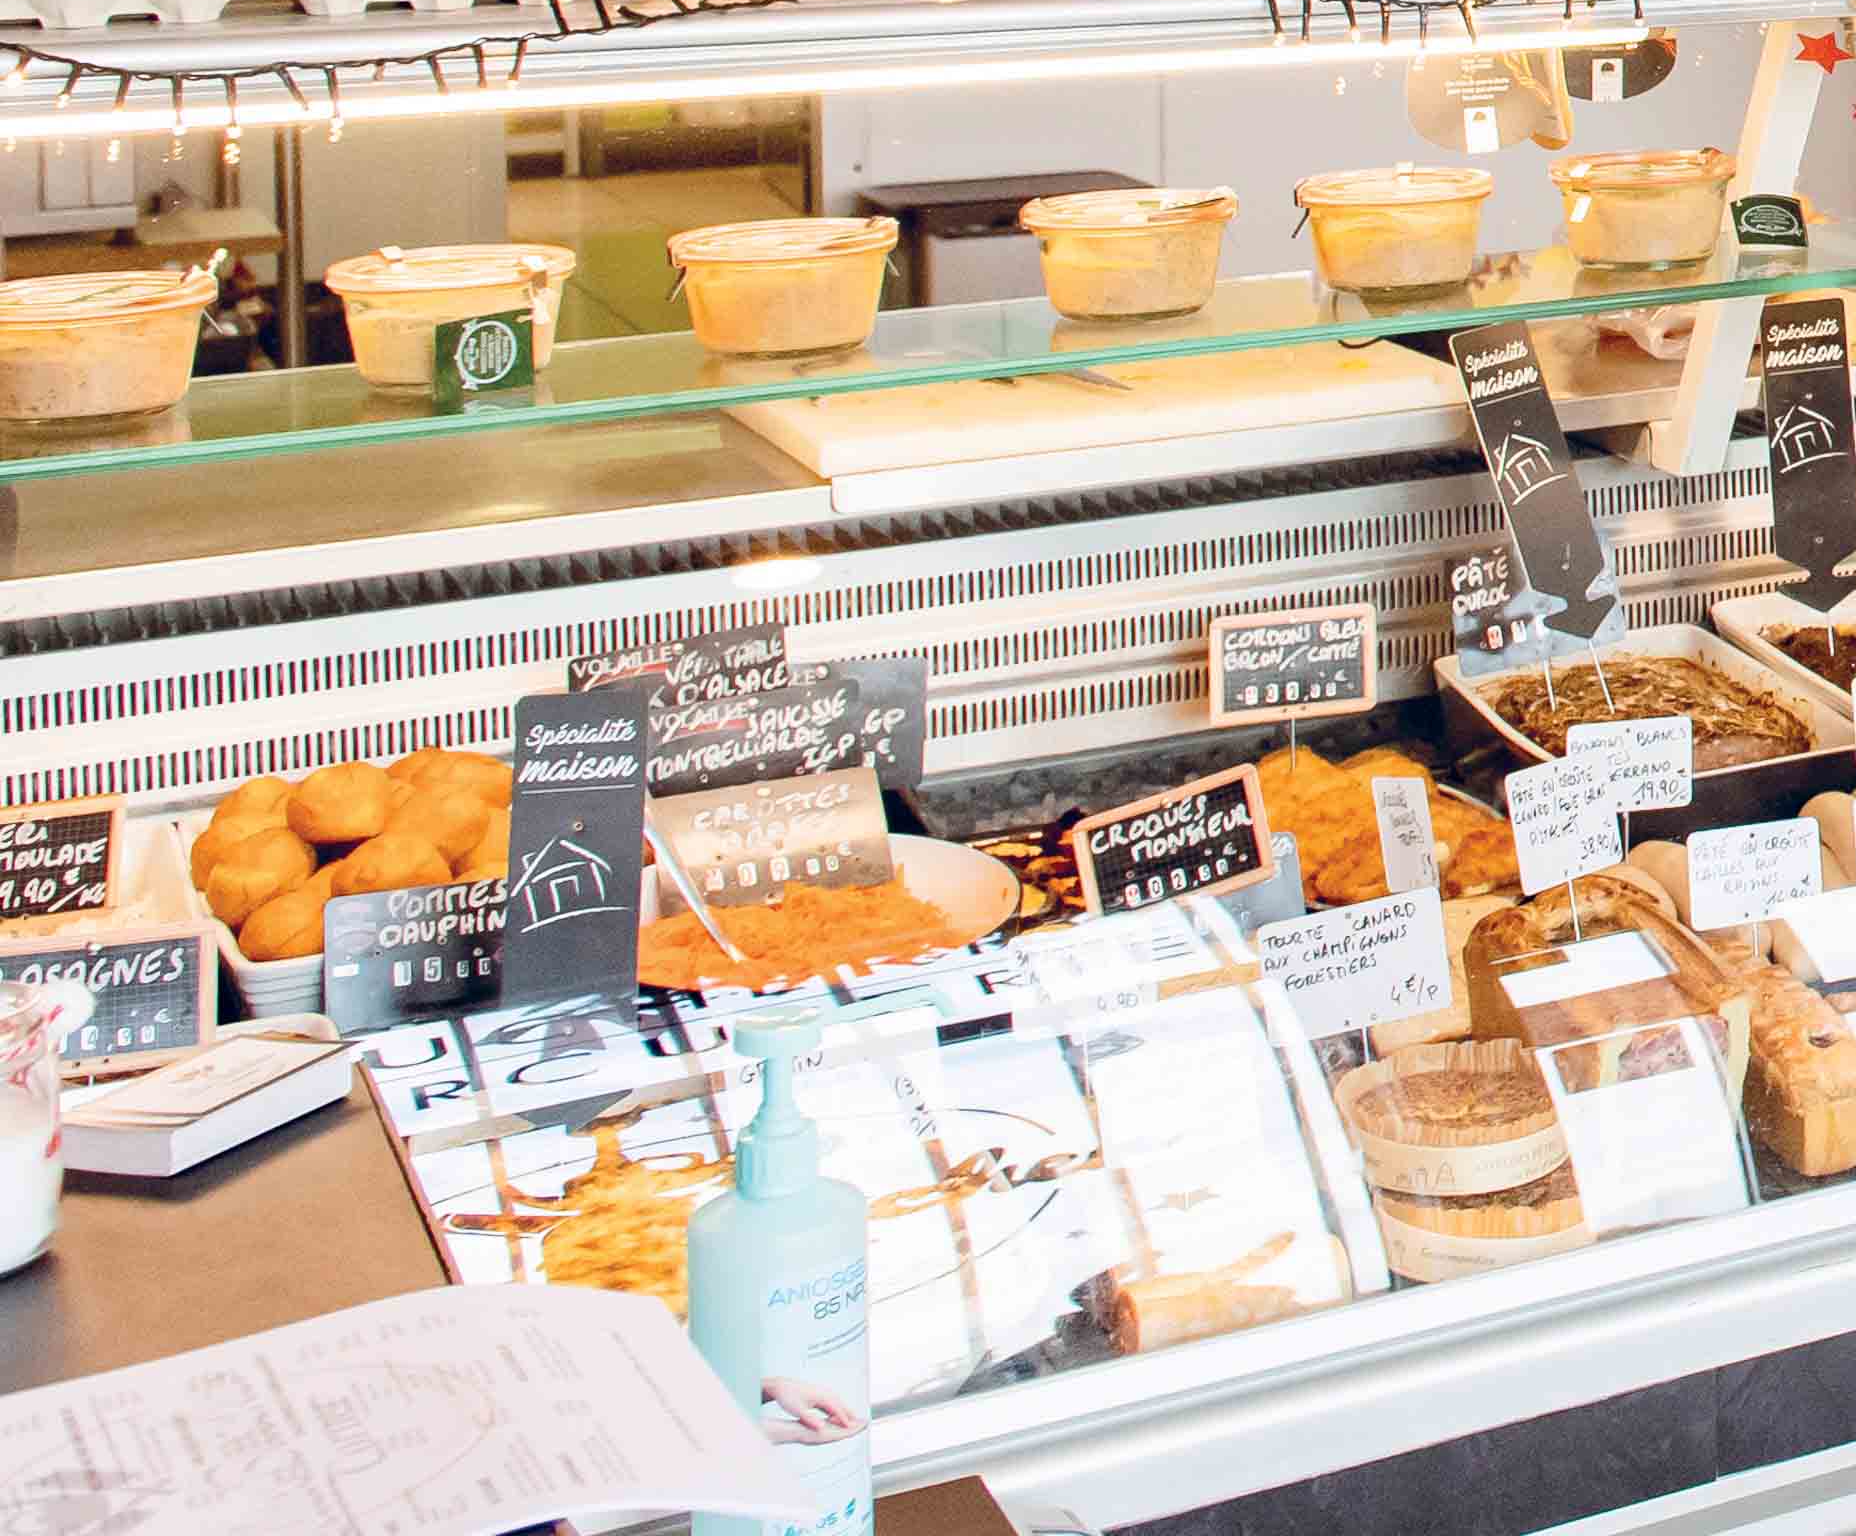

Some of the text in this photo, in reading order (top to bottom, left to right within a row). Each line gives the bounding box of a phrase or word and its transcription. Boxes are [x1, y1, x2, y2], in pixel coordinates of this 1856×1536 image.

[1767, 318, 1840, 344] Spécialité
[1464, 339, 1529, 373] Spécialité
[1767, 343, 1843, 368] maison
[1470, 363, 1539, 400] maison
[525, 719, 637, 754] Spécialité
[518, 751, 639, 783] maison
[1090, 794, 1208, 854] CROQUES
[1264, 902, 1416, 950] TOURTE CANARD
[813, 1295, 840, 1319] 85
